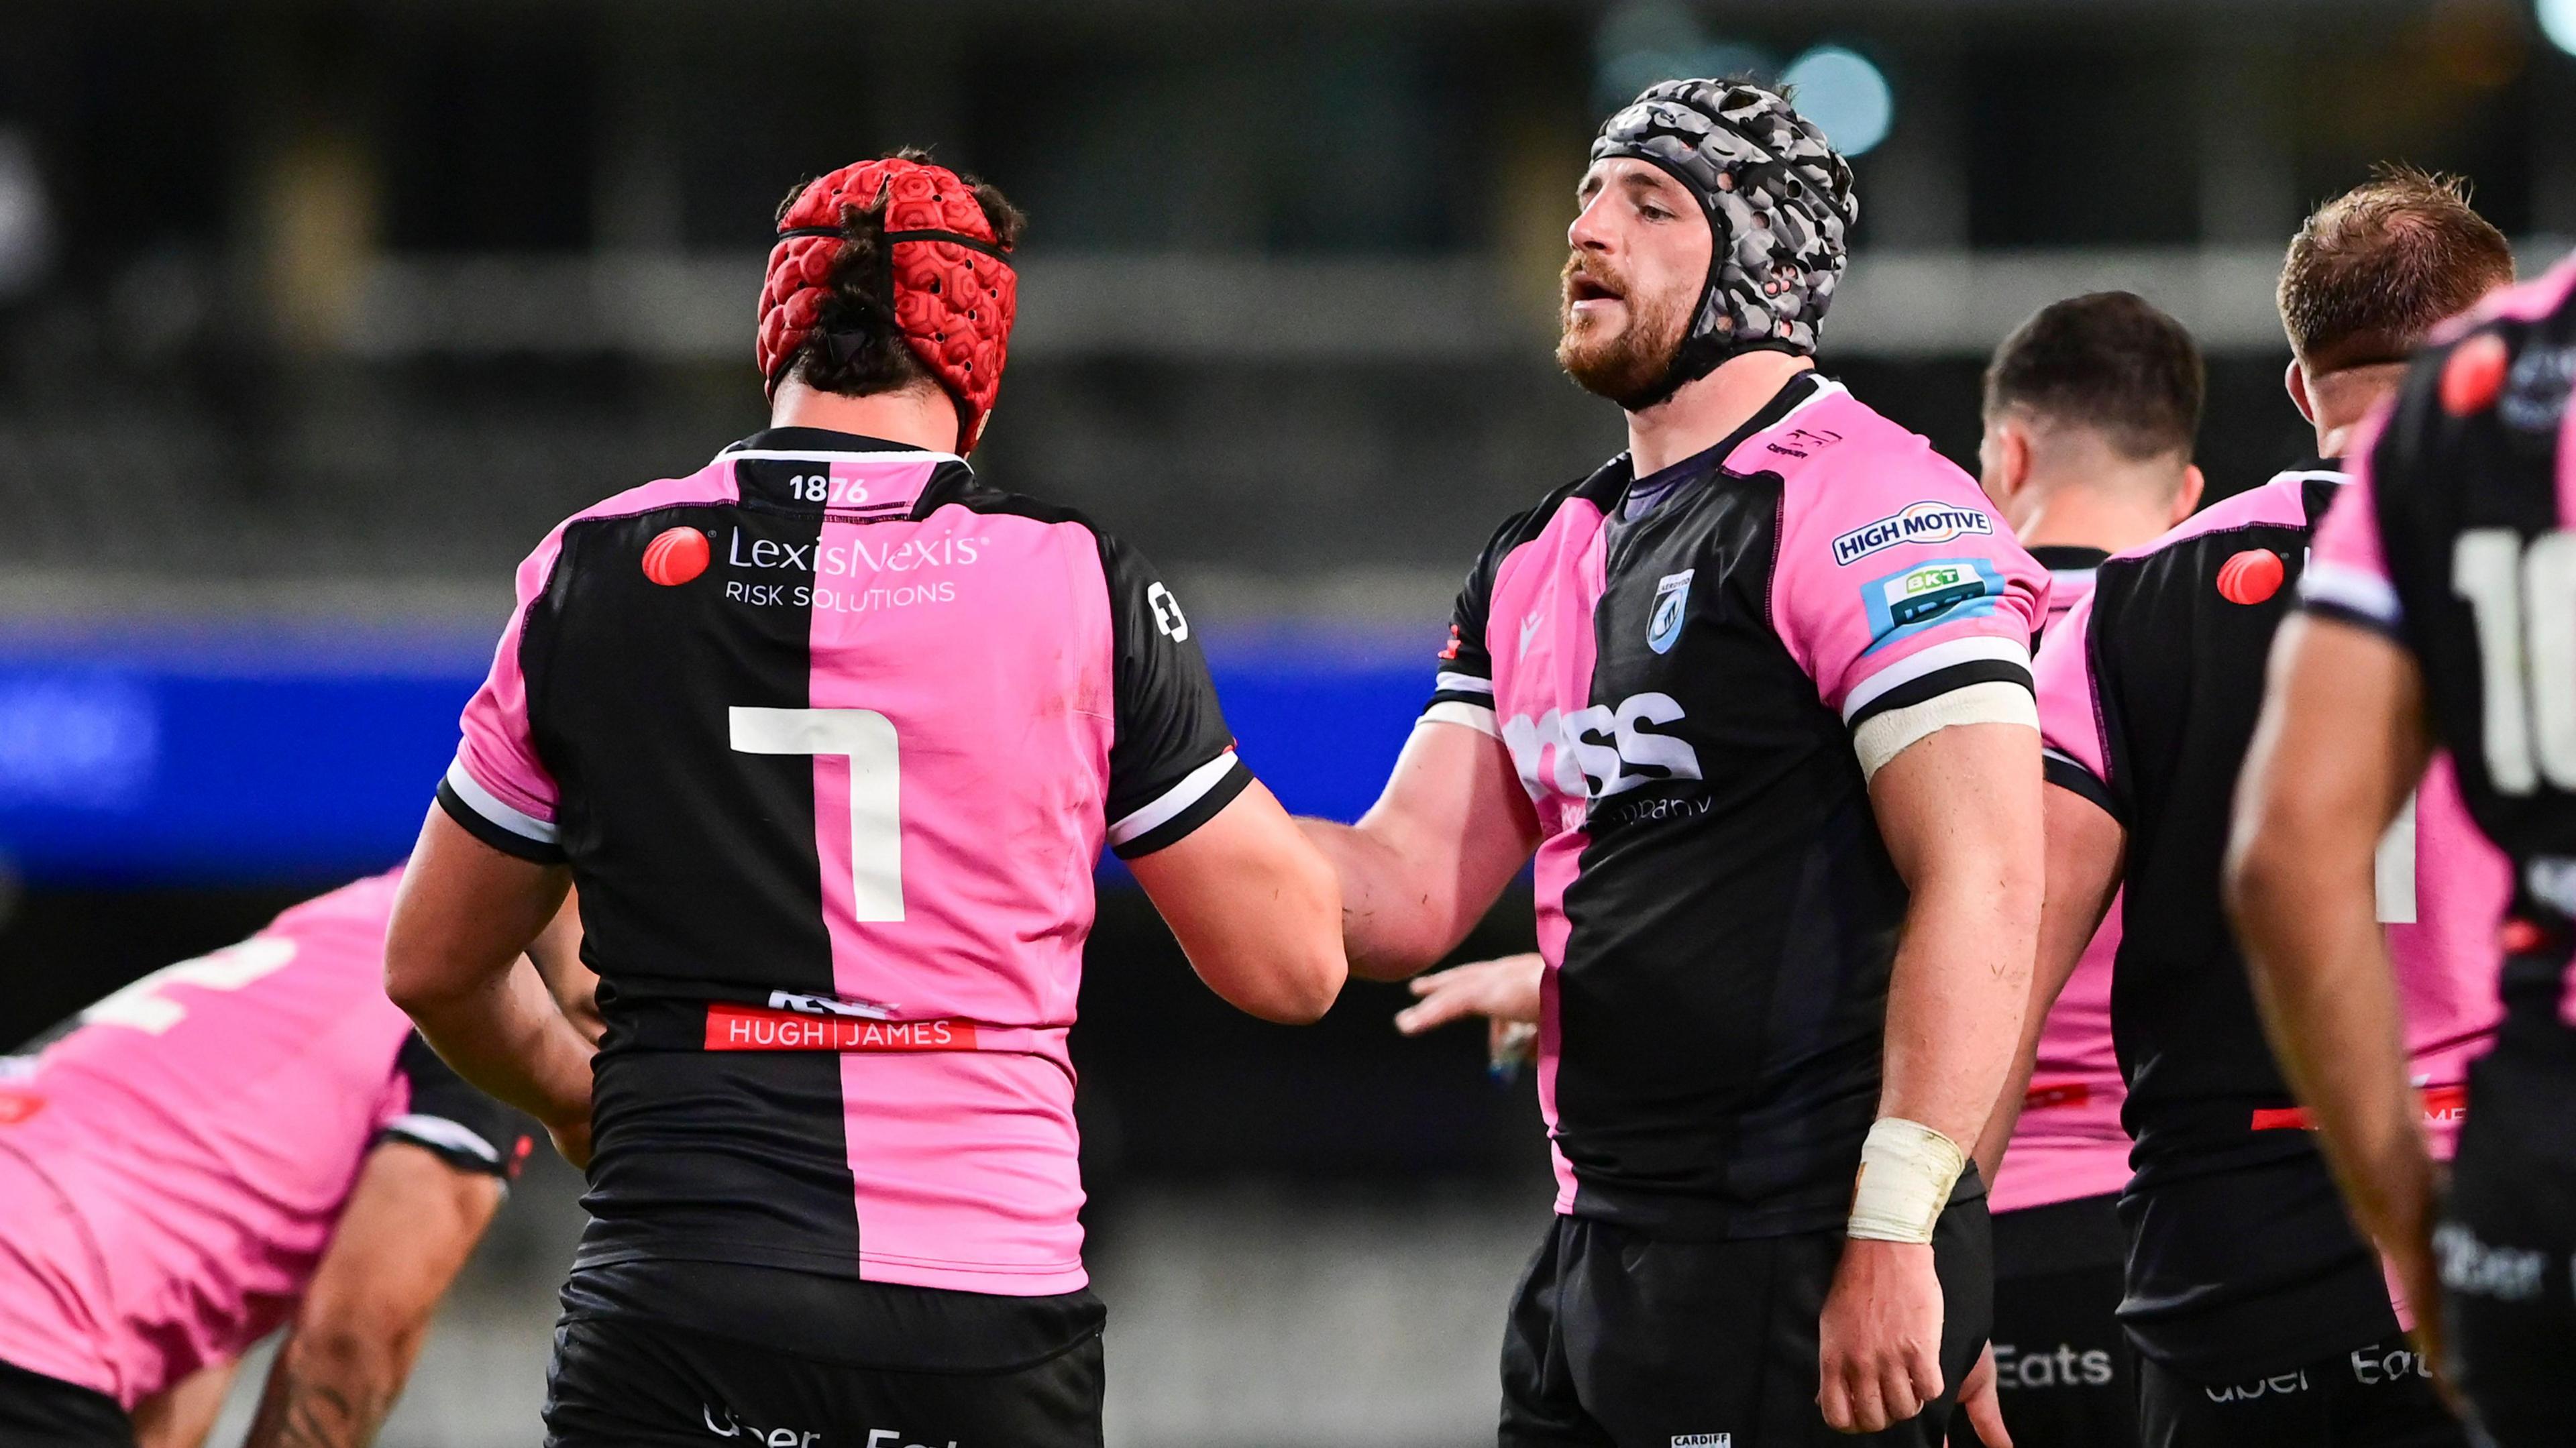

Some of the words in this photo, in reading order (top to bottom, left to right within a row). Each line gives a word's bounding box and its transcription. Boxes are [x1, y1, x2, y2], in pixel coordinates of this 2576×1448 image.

[789, 475, 868, 504] 1876
[1839, 520, 1900, 559] HIGH
[1903, 512, 1988, 536] MOTIVE
[725, 581, 784, 606] RISK
[793, 581, 956, 613] SOLUTIONS
[1907, 569, 1960, 594] BKT
[729, 706, 906, 922] 7
[729, 1019, 824, 1046] HUGH
[845, 1020, 952, 1046] JAMES
[1991, 1343, 2112, 1387] Eats
[2351, 1344, 2433, 1385] Eat
[1674, 1433, 1728, 1446] CARDIFF
